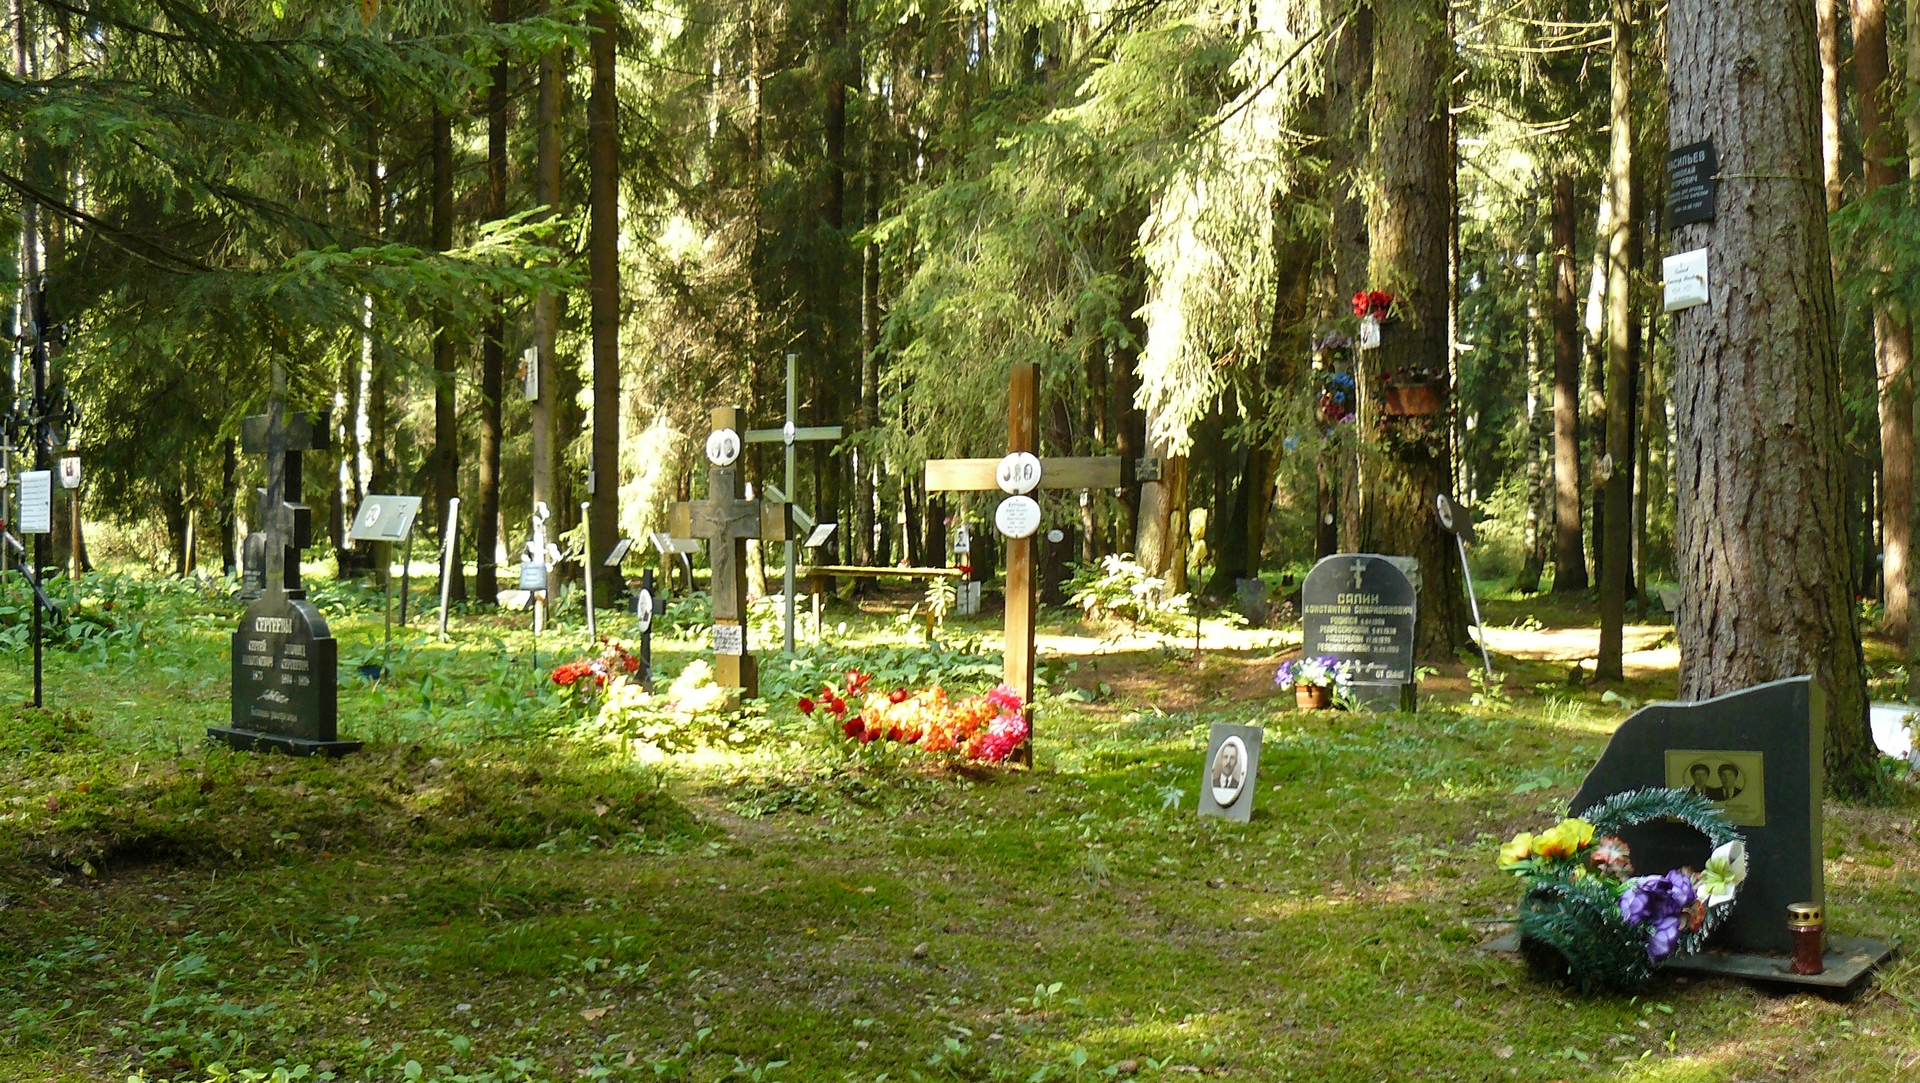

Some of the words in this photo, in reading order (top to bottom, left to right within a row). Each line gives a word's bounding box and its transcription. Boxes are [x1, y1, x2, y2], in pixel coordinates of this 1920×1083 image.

[1337, 593, 1379, 605] САЛИН
[1304, 604, 1351, 614] КОНСТАНТИН
[1354, 605, 1413, 615] СПИРИДОНОВИЧ
[256, 617, 293, 633] СЕРГЕЕВЫ
